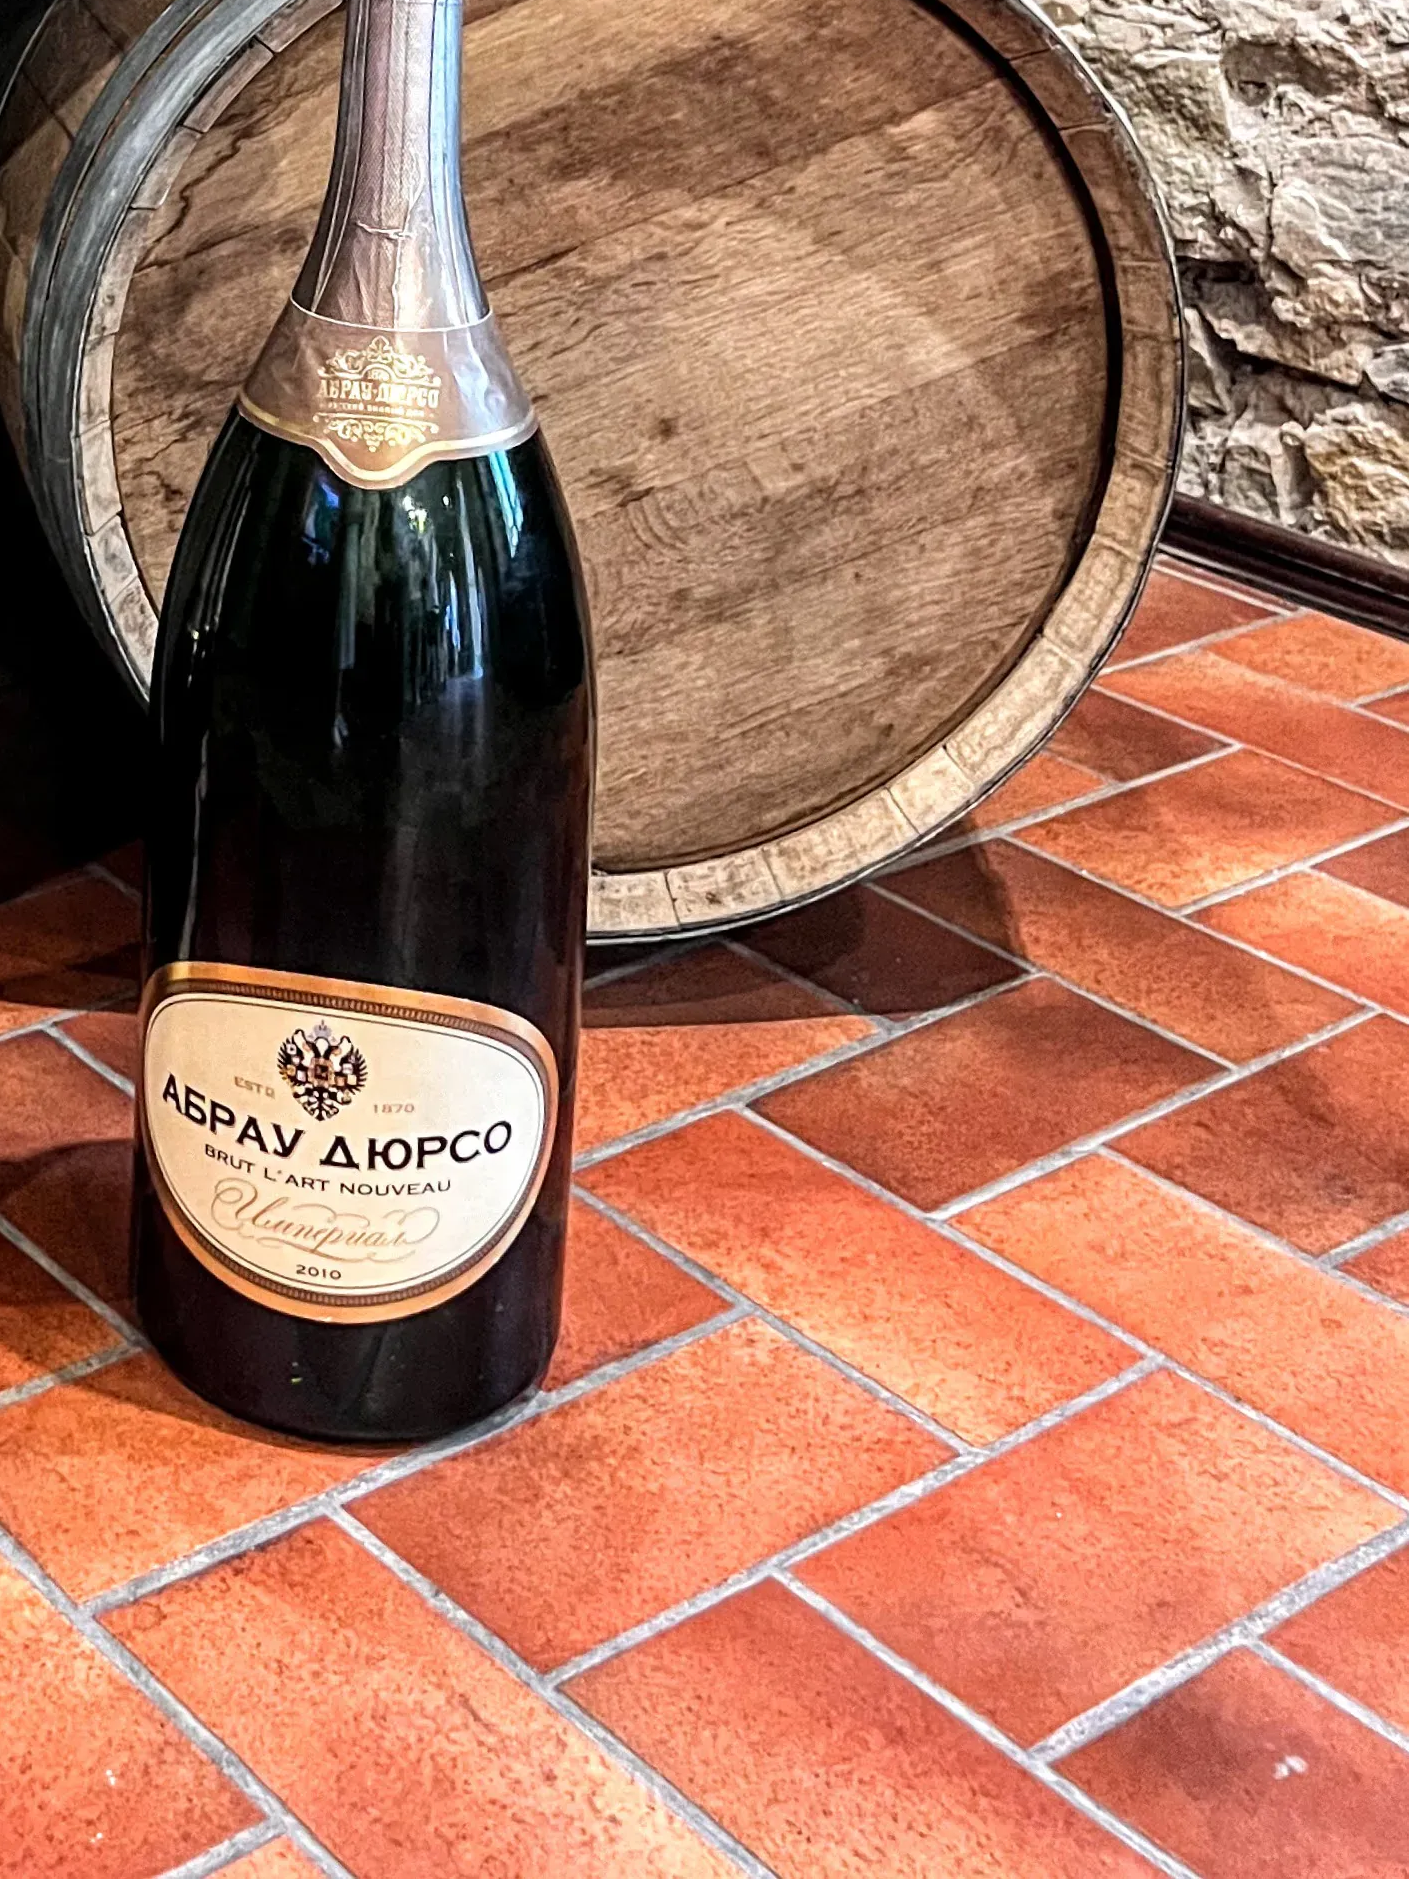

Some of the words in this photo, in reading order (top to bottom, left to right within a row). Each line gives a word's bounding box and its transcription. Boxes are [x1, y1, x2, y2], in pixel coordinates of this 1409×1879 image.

[162, 1072, 306, 1159] АБРАУ
[319, 1120, 512, 1170] ДЮРСО
[373, 1103, 415, 1114] 1870
[204, 1143, 256, 1174] BRUT
[340, 1179, 452, 1197] NOUVEAU
[295, 1264, 342, 1281] 2010
